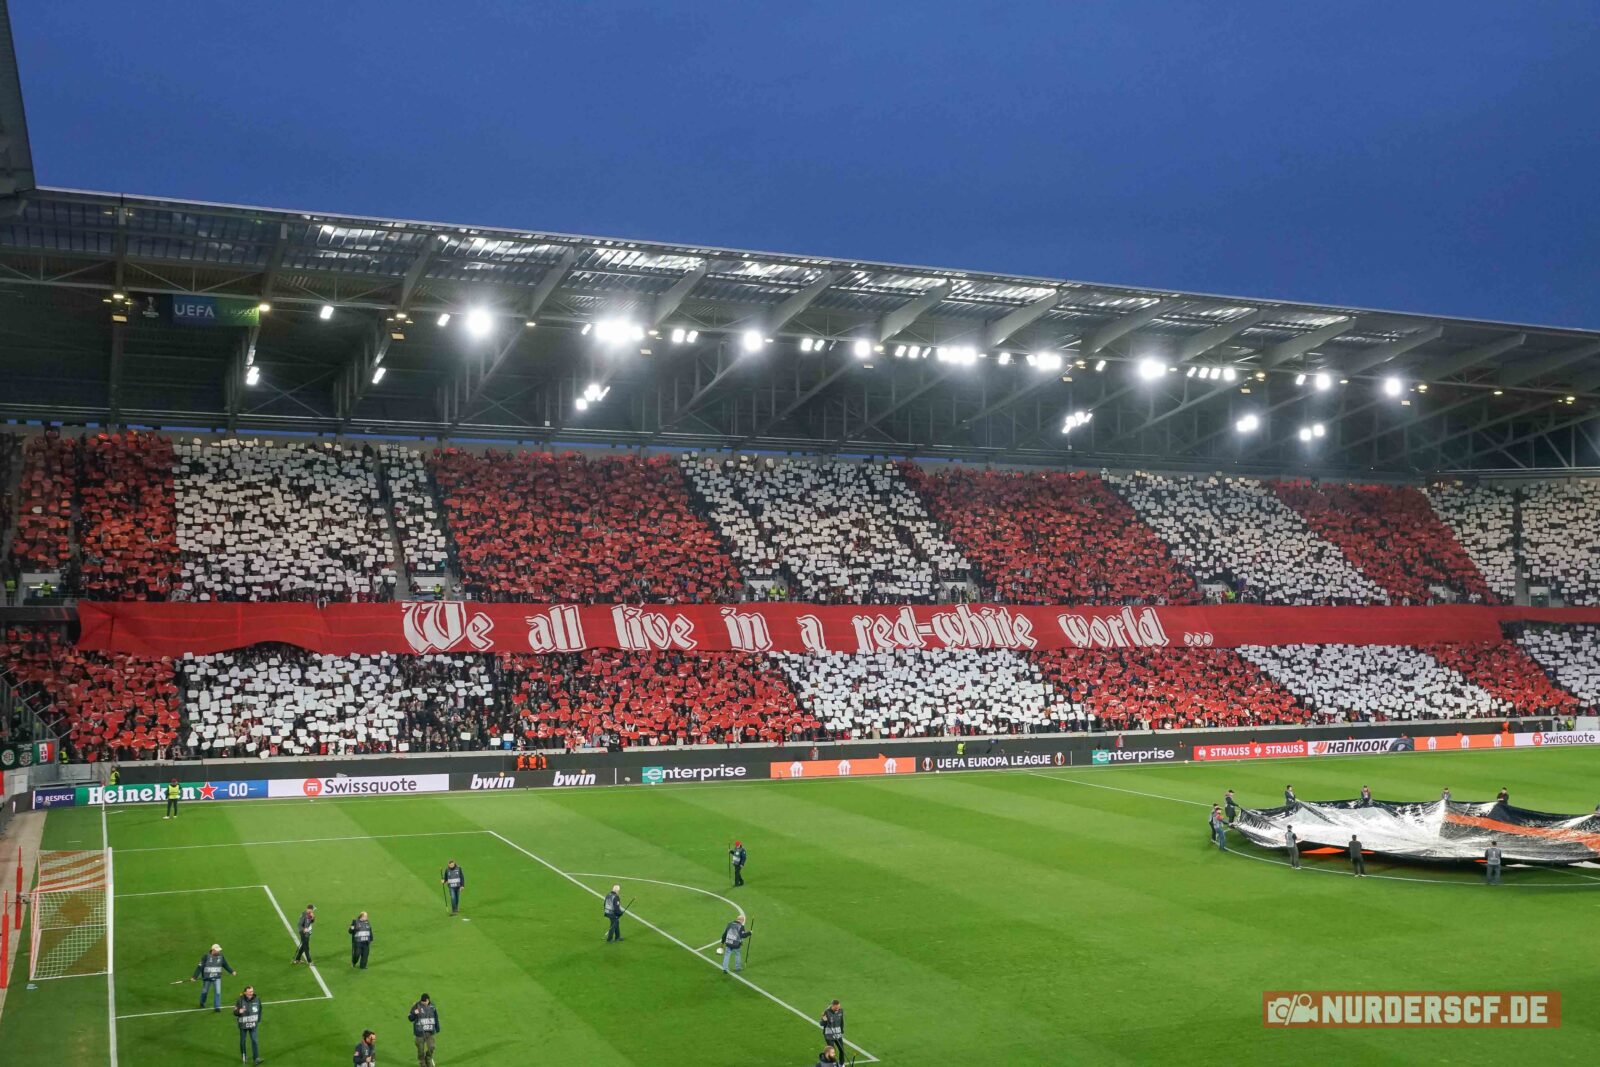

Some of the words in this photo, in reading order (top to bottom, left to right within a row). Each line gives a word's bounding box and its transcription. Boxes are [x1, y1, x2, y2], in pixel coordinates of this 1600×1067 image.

[174, 304, 215, 318] UEFA
[401, 601, 494, 654] We
[525, 604, 587, 653] all
[610, 602, 698, 652] live
[719, 606, 773, 652] in
[797, 614, 826, 652] a
[851, 604, 1037, 654] red-white
[1056, 605, 1170, 648] world
[1543, 733, 1596, 745] Swissquote
[1094, 748, 1175, 763] enterprise
[1210, 746, 1250, 757] STRAUSS
[1265, 744, 1304, 754] STRAUSS
[937, 757, 966, 768] UEFA
[968, 756, 1009, 768] EUROPA
[1011, 754, 1051, 766] LEAGUE
[553, 769, 596, 786] bwin
[643, 764, 747, 781] enterprise
[324, 778, 417, 794] Swissquote
[470, 772, 515, 790] bwin
[45, 793, 74, 802] RESPECT
[87, 784, 196, 805] Heinekn
